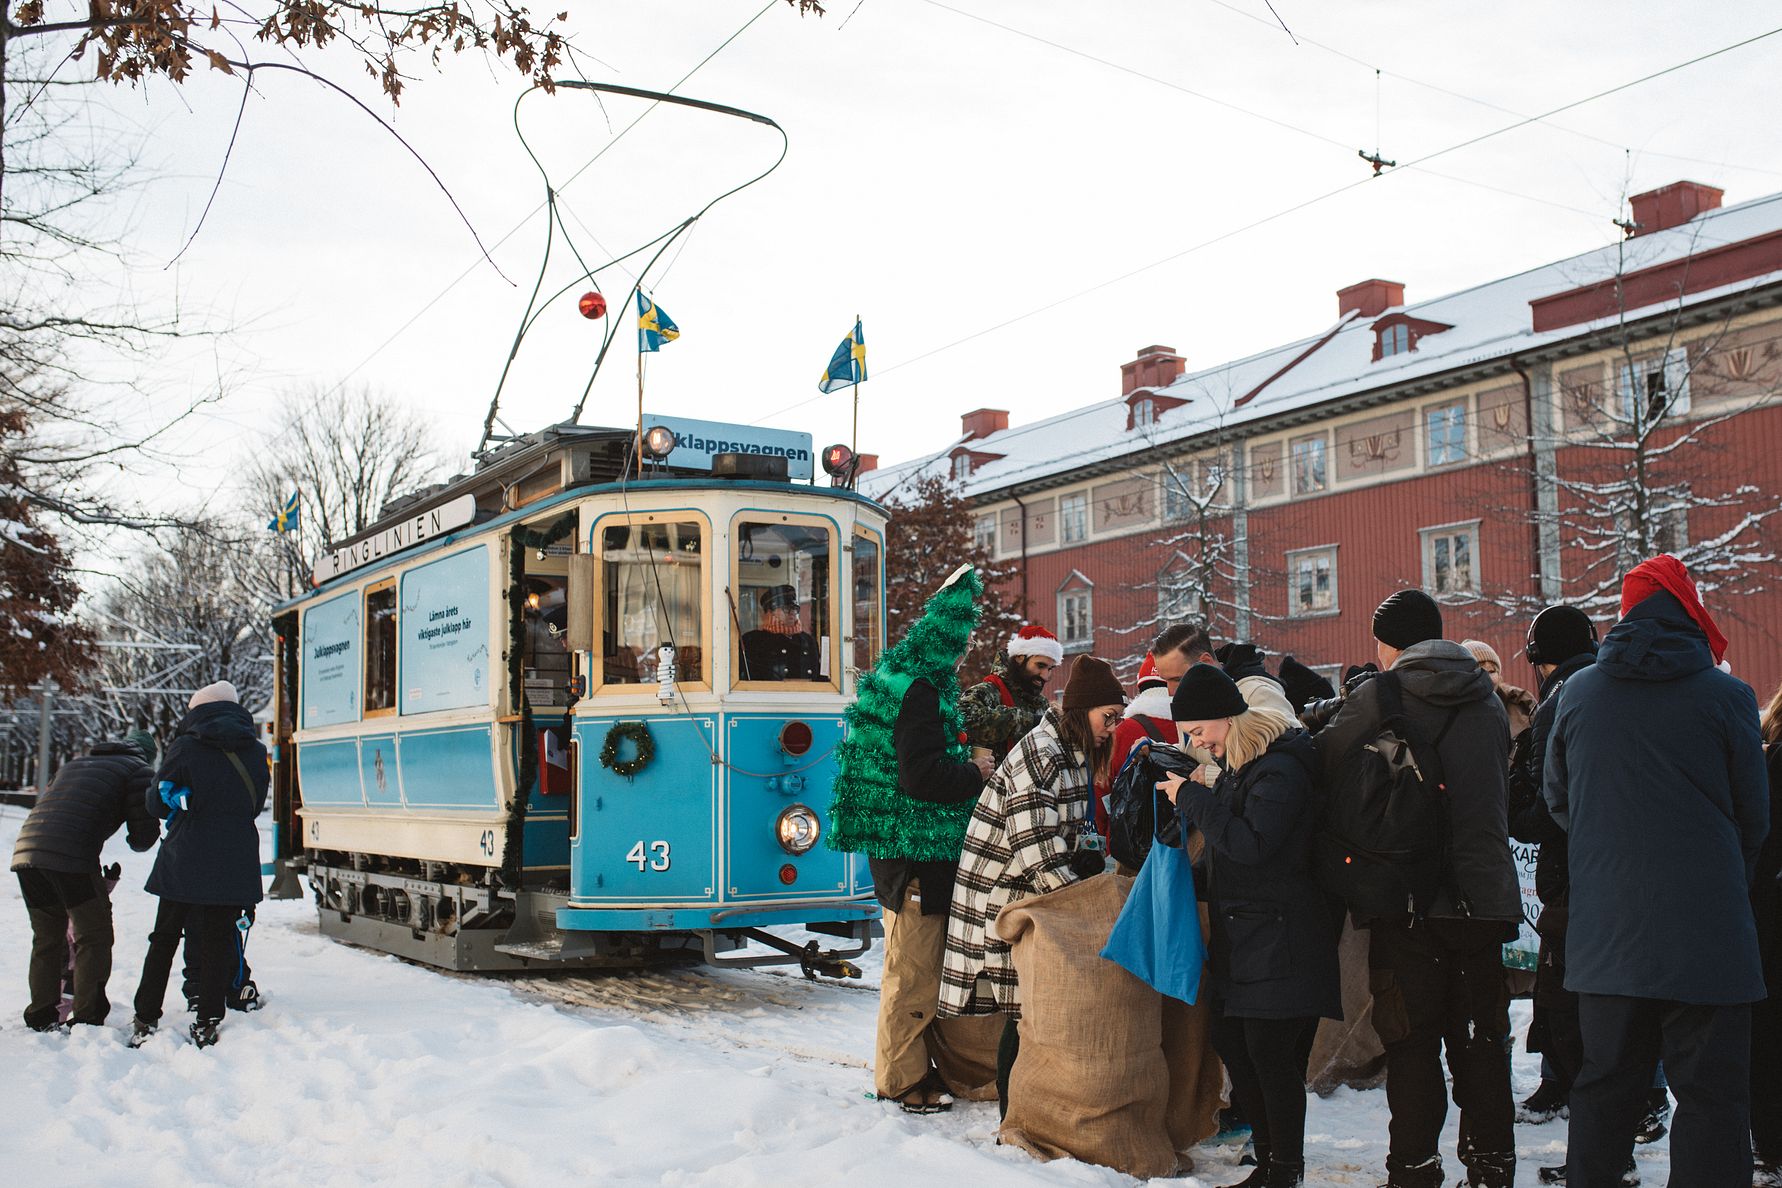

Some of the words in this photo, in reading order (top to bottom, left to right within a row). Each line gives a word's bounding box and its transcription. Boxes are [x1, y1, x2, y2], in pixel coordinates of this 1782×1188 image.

[333, 508, 441, 574] RINGLINIEN
[428, 609, 445, 622] Lämna
[445, 605, 459, 618] årets
[418, 625, 441, 641] viktigaste
[441, 620, 462, 638] julklapp
[462, 617, 472, 631] här
[311, 820, 320, 841] 43
[480, 829, 494, 857] 43
[626, 840, 672, 872] 43
